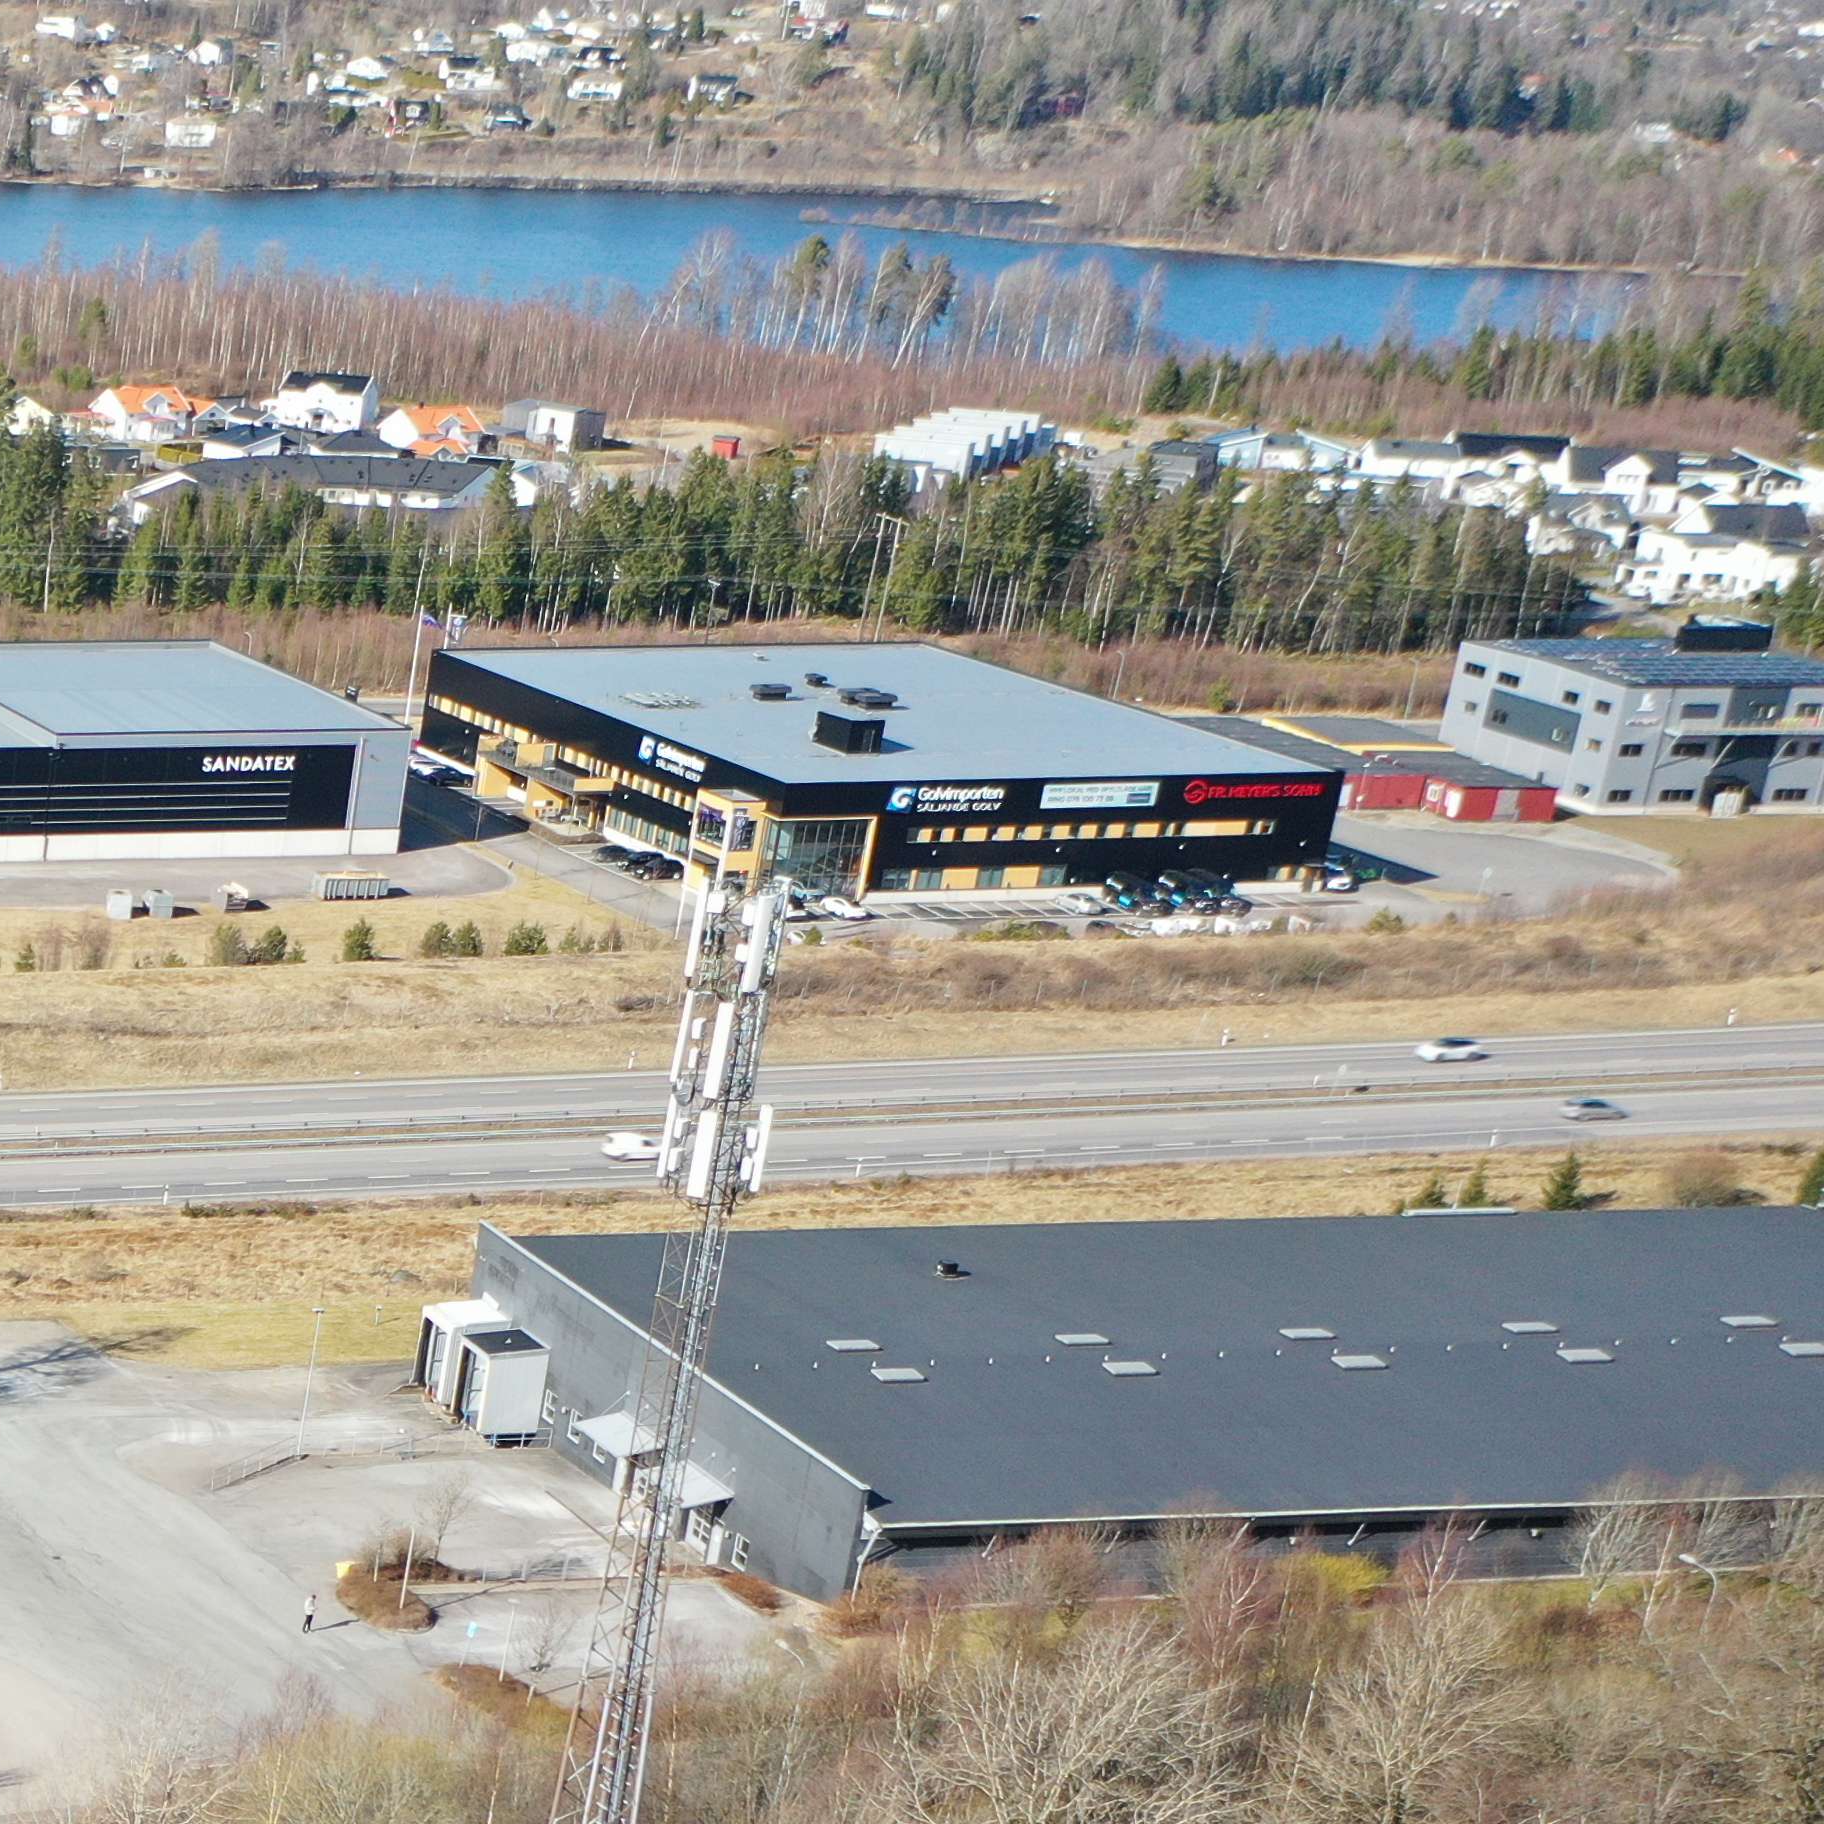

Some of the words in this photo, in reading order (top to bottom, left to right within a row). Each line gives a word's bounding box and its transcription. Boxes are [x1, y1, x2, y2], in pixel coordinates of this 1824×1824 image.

[201, 755, 295, 773] SANDATEX
[918, 786, 1005, 803] Golvimporten
[971, 802, 1002, 811] GOLV
